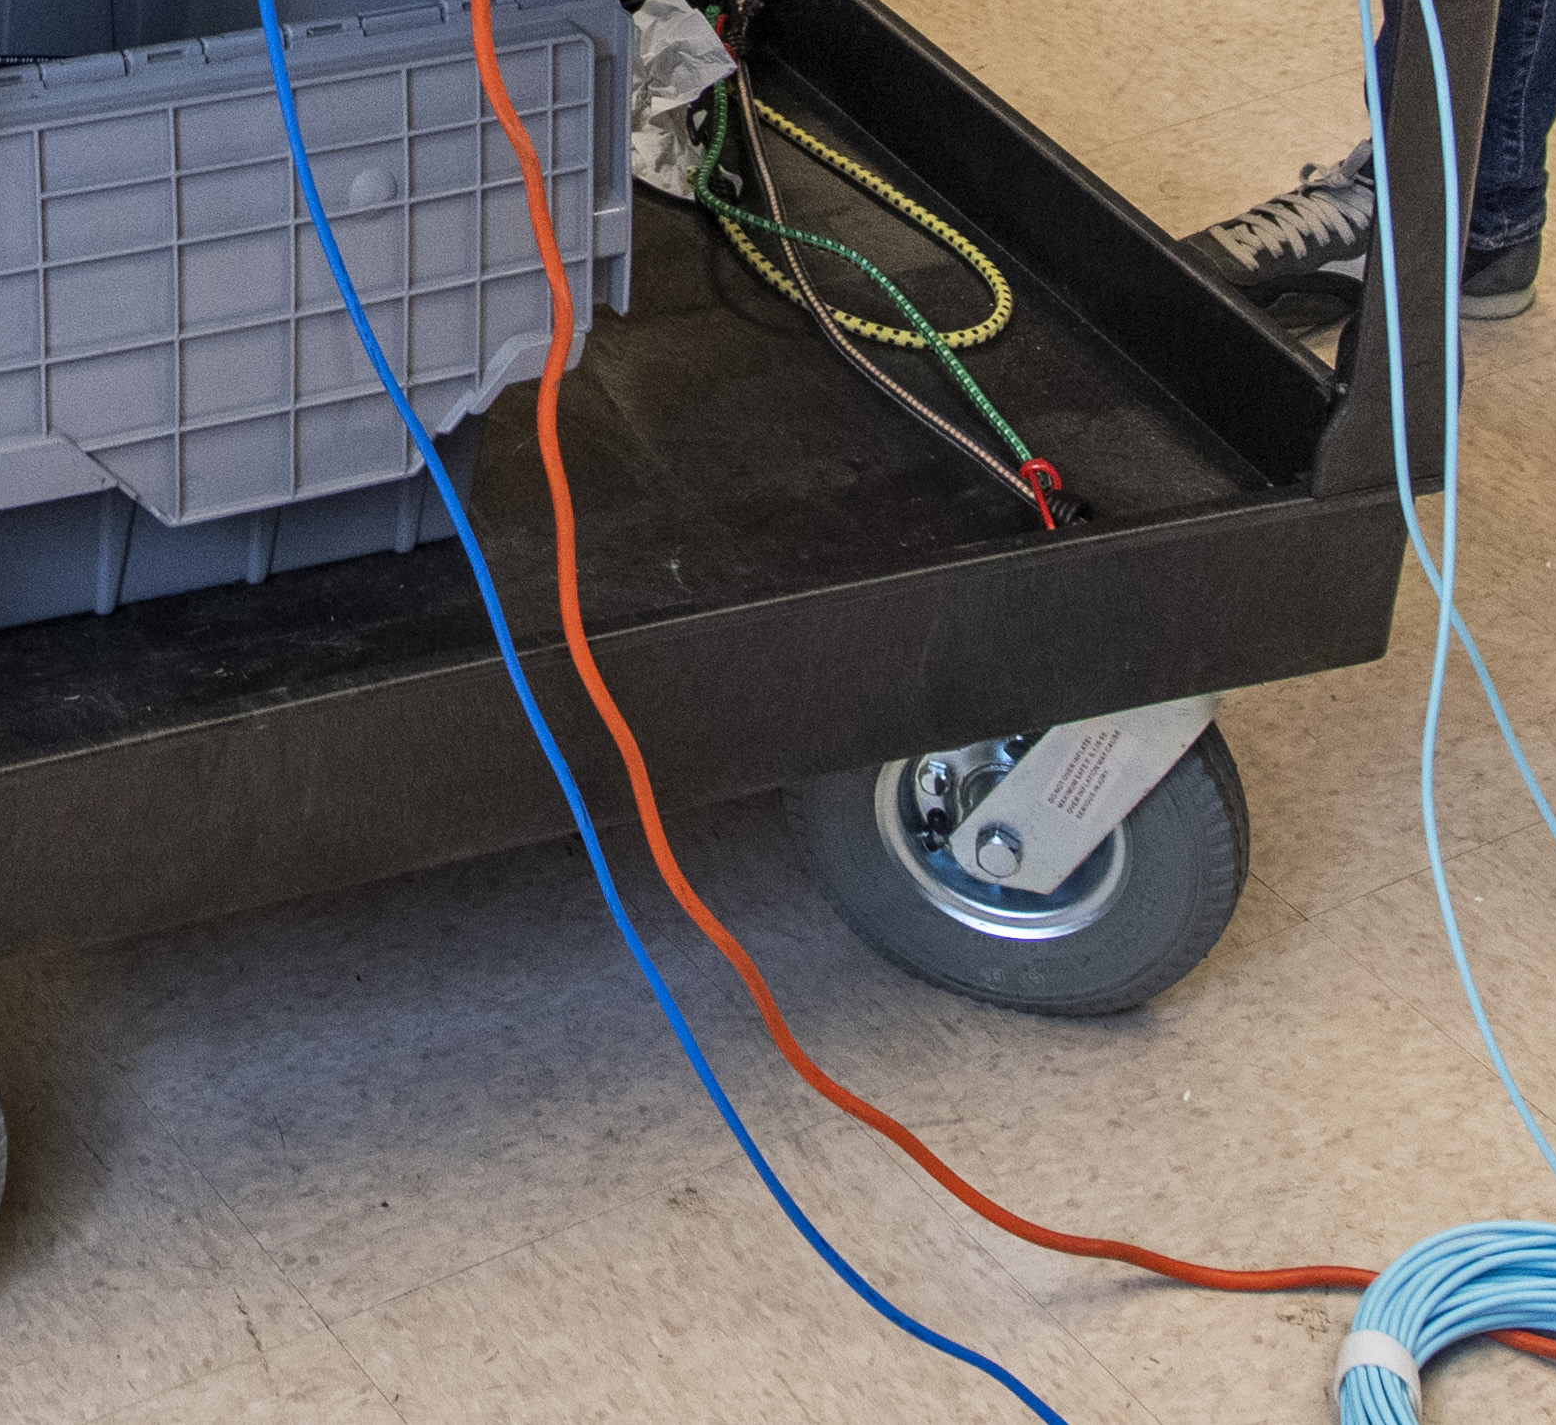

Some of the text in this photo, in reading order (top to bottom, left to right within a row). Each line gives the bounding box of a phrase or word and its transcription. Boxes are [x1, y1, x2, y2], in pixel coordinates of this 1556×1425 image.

[1048, 793, 1058, 805] DO
[1054, 779, 1066, 795] NOT
[1062, 762, 1076, 782] OVER
[1057, 778, 1078, 810] MAXIMUM
[1074, 763, 1089, 780] SAFE
[1066, 729, 1122, 815] OVER INFLATION MAY CAUSE
[1075, 790, 1097, 820] SERIOUS
